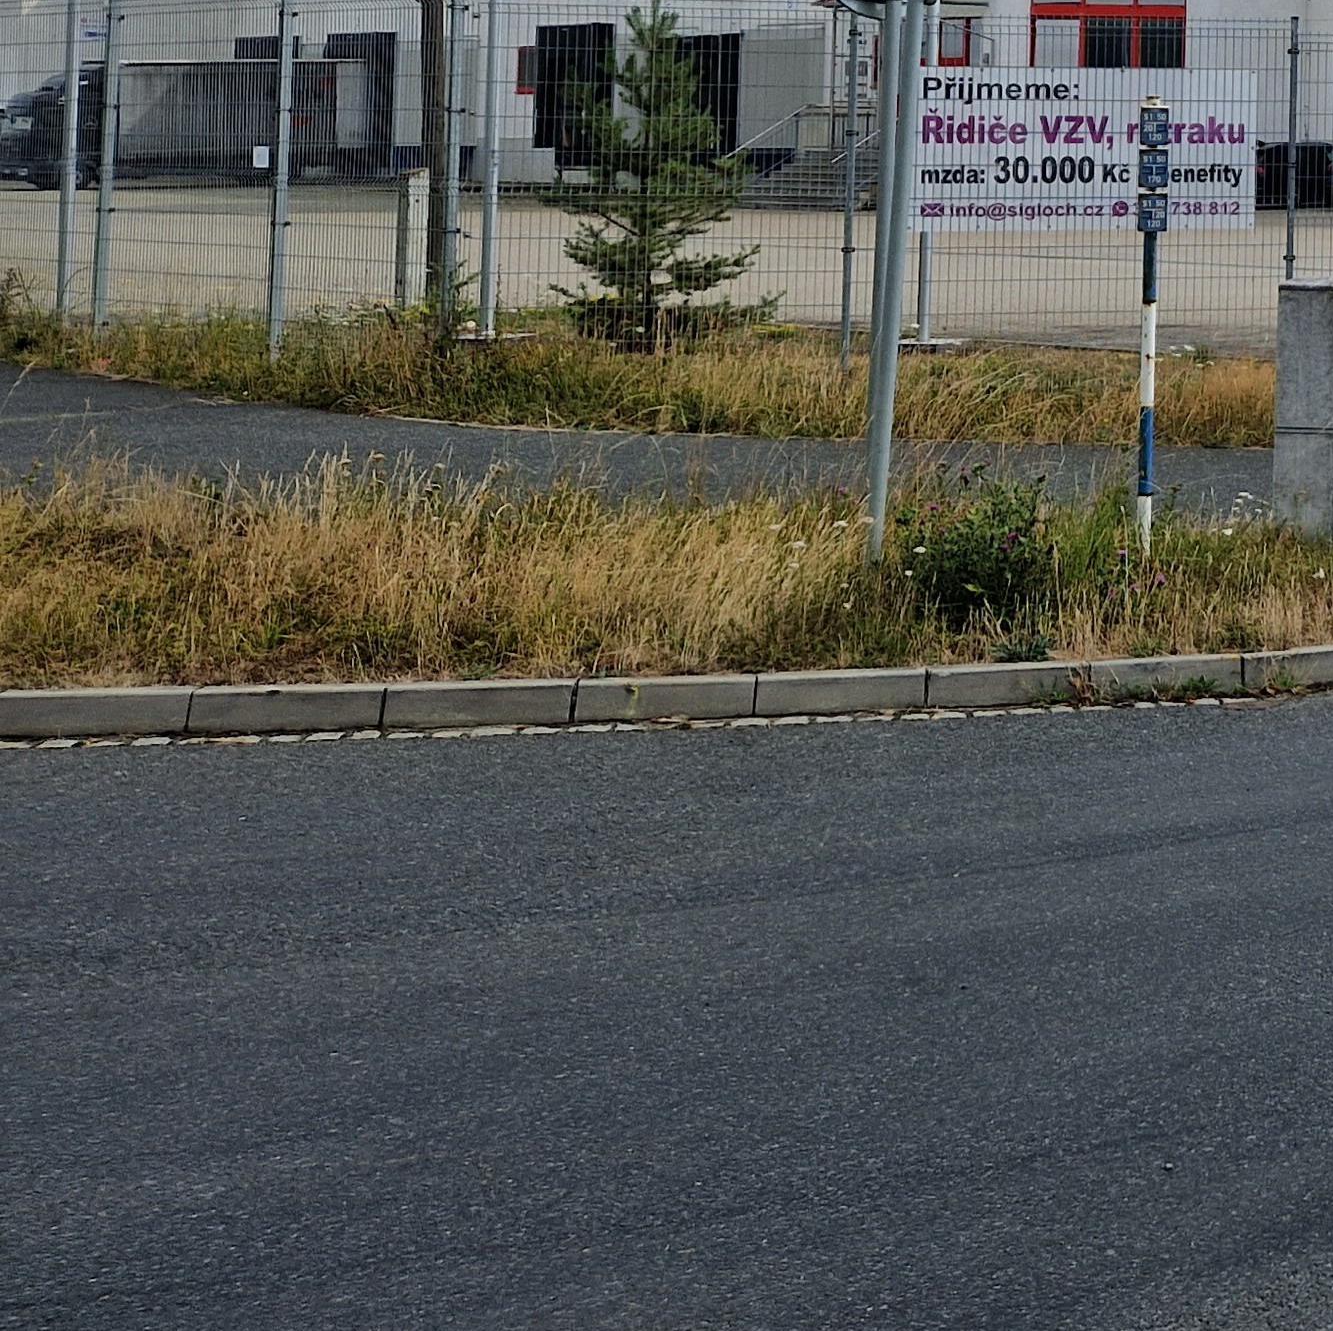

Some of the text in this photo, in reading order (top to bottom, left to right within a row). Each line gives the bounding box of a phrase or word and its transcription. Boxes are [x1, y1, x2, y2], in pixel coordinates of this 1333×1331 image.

[922, 77, 1079, 105] Přijmeme:
[921, 108, 1245, 150] Řidiče VZV, rraku
[920, 156, 1243, 188] mzda: 30.000 Kč enefity
[950, 201, 1241, 221] info@sigloch.cz 738 812
